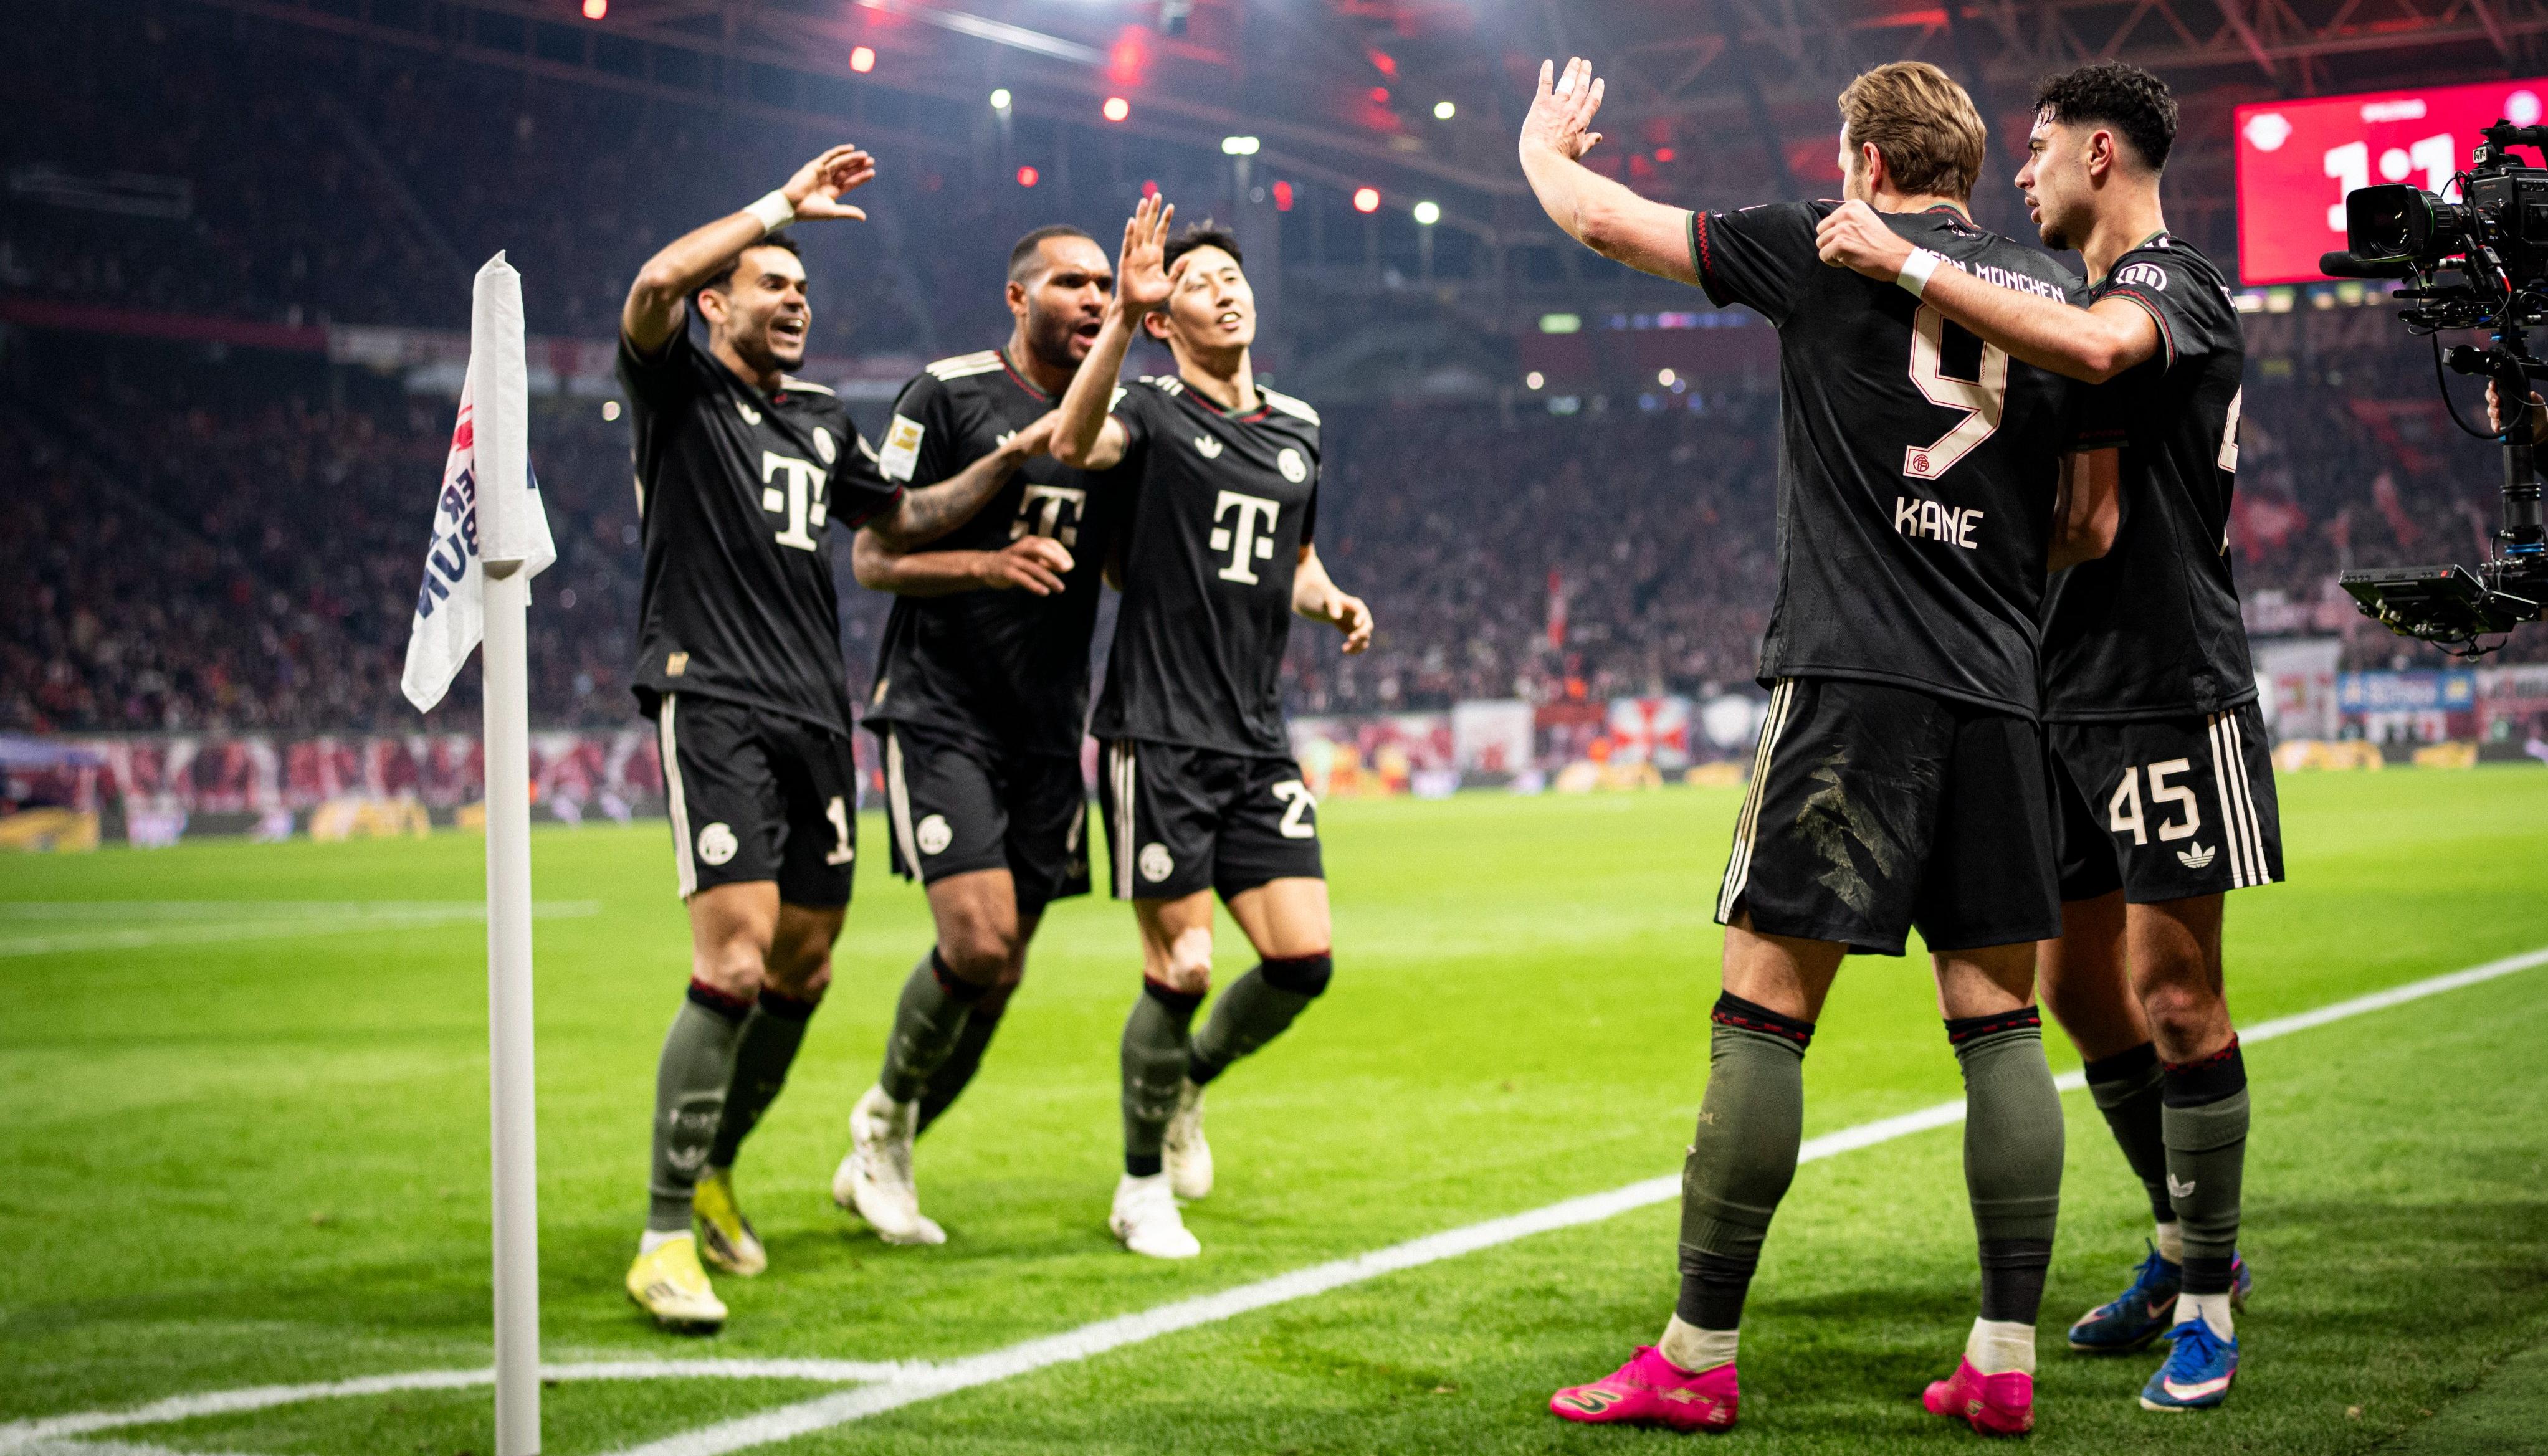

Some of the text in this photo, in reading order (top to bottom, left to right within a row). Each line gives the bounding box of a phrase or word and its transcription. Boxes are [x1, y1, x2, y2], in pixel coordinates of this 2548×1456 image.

[1903, 303, 2008, 480] 9
[763, 450, 827, 551] T
[1210, 490, 1280, 585] T
[1895, 497, 1984, 549] KANE
[1272, 779, 1317, 839] 2
[2109, 758, 2200, 845] 45
